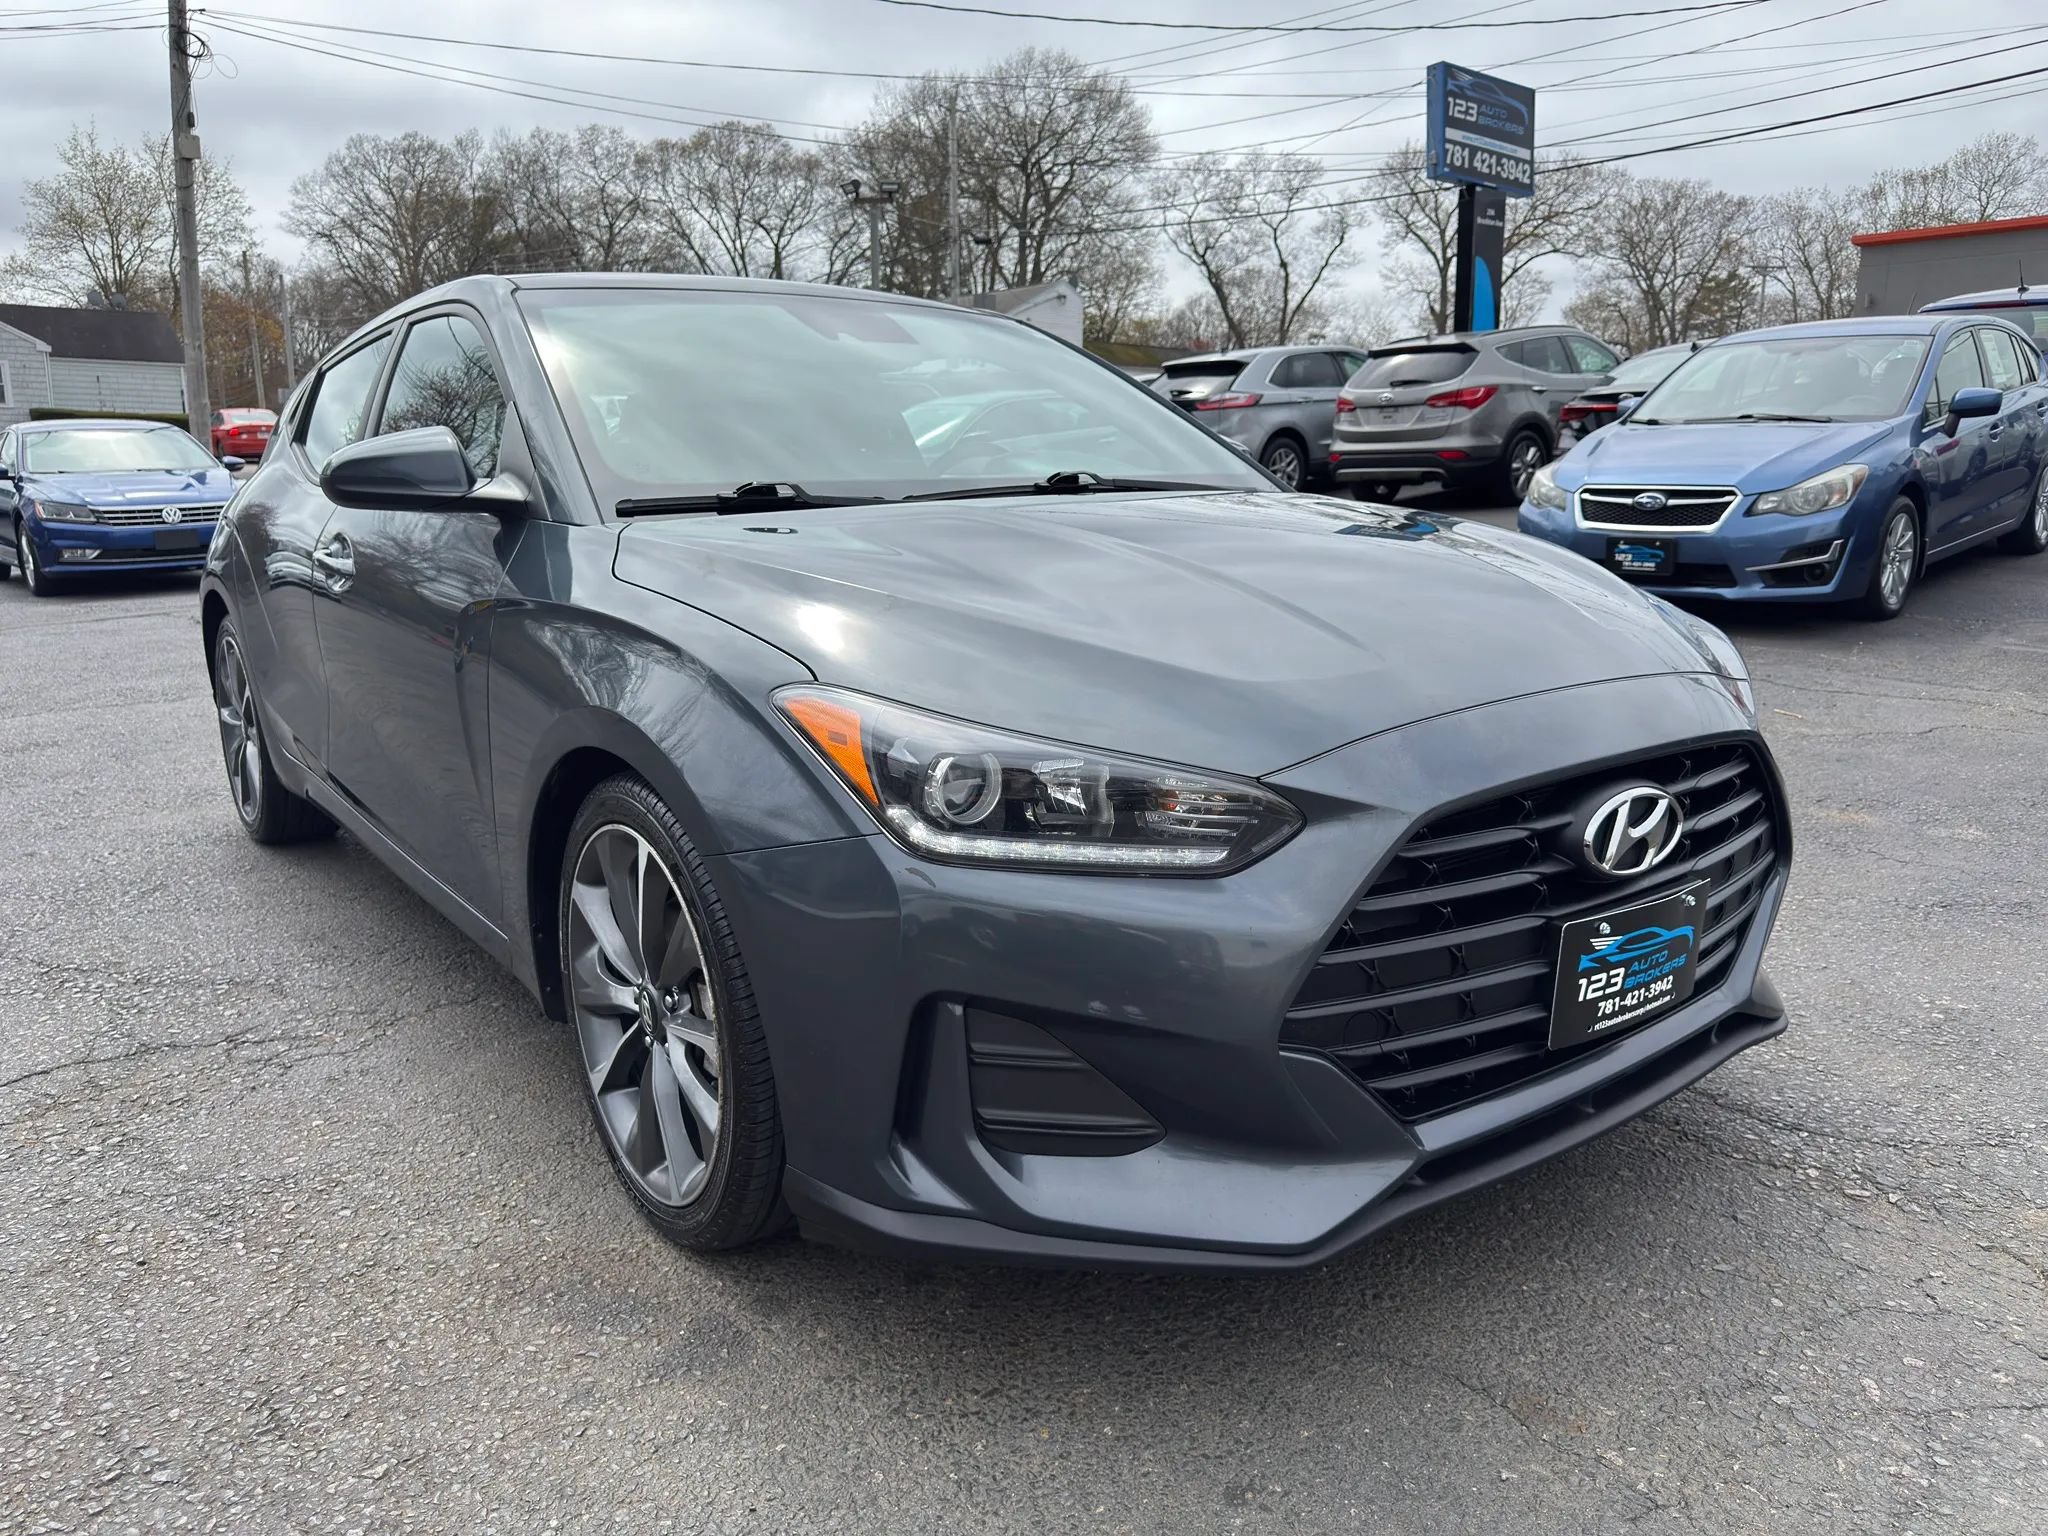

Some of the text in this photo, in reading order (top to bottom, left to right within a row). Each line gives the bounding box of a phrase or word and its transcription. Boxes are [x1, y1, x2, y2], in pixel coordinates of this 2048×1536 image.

[1448, 97, 1478, 122] 123
[1479, 104, 1508, 118] AUTO
[1478, 115, 1525, 135] BROKERS
[1445, 143, 1469, 168] 781
[1473, 151, 1531, 184] 421-3942
[1623, 953, 1687, 989] BROKERS
[1627, 950, 1668, 974] AUTO
[1578, 967, 1626, 1002] 123
[1597, 975, 1674, 1017] 781-421-3942
